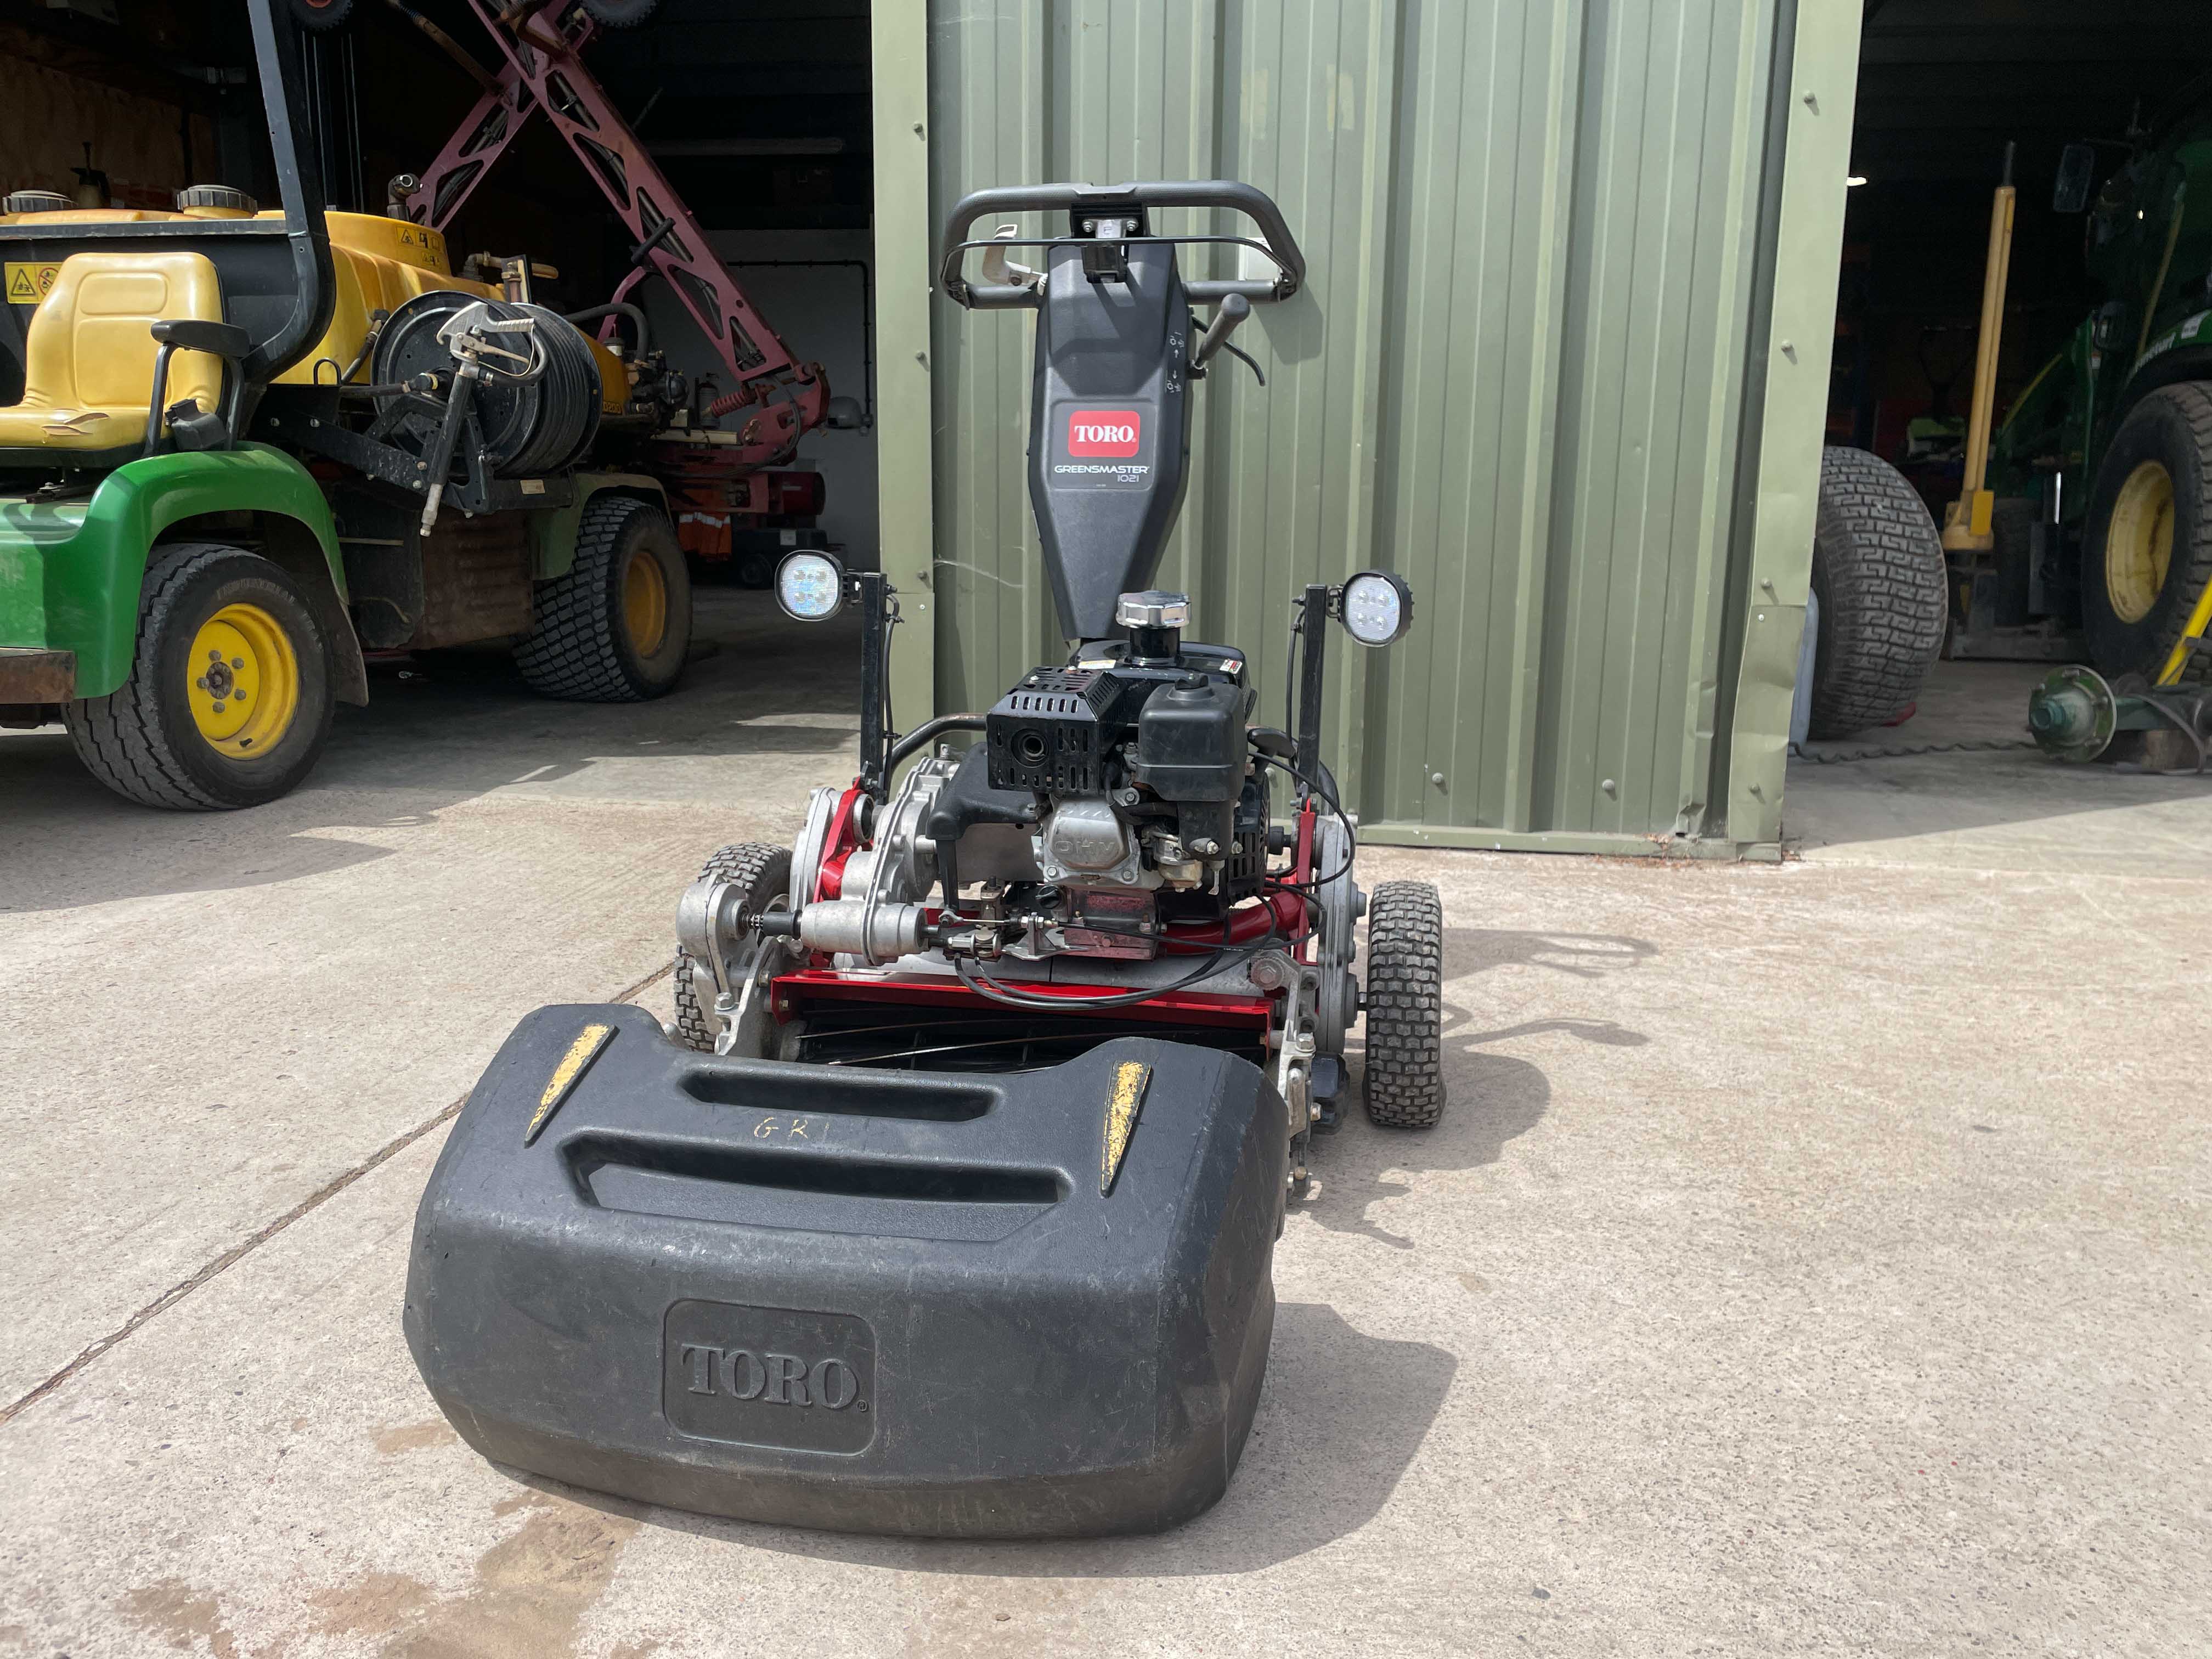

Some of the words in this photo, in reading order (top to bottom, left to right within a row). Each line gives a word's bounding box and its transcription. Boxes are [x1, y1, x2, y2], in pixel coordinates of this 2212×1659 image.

[1074, 425, 1135, 443] TORO
[1054, 465, 1149, 475] GREENSMASTER
[1117, 475, 1139, 483] 1021
[1054, 840, 1115, 855] OHV
[681, 1343, 860, 1410] TORO
